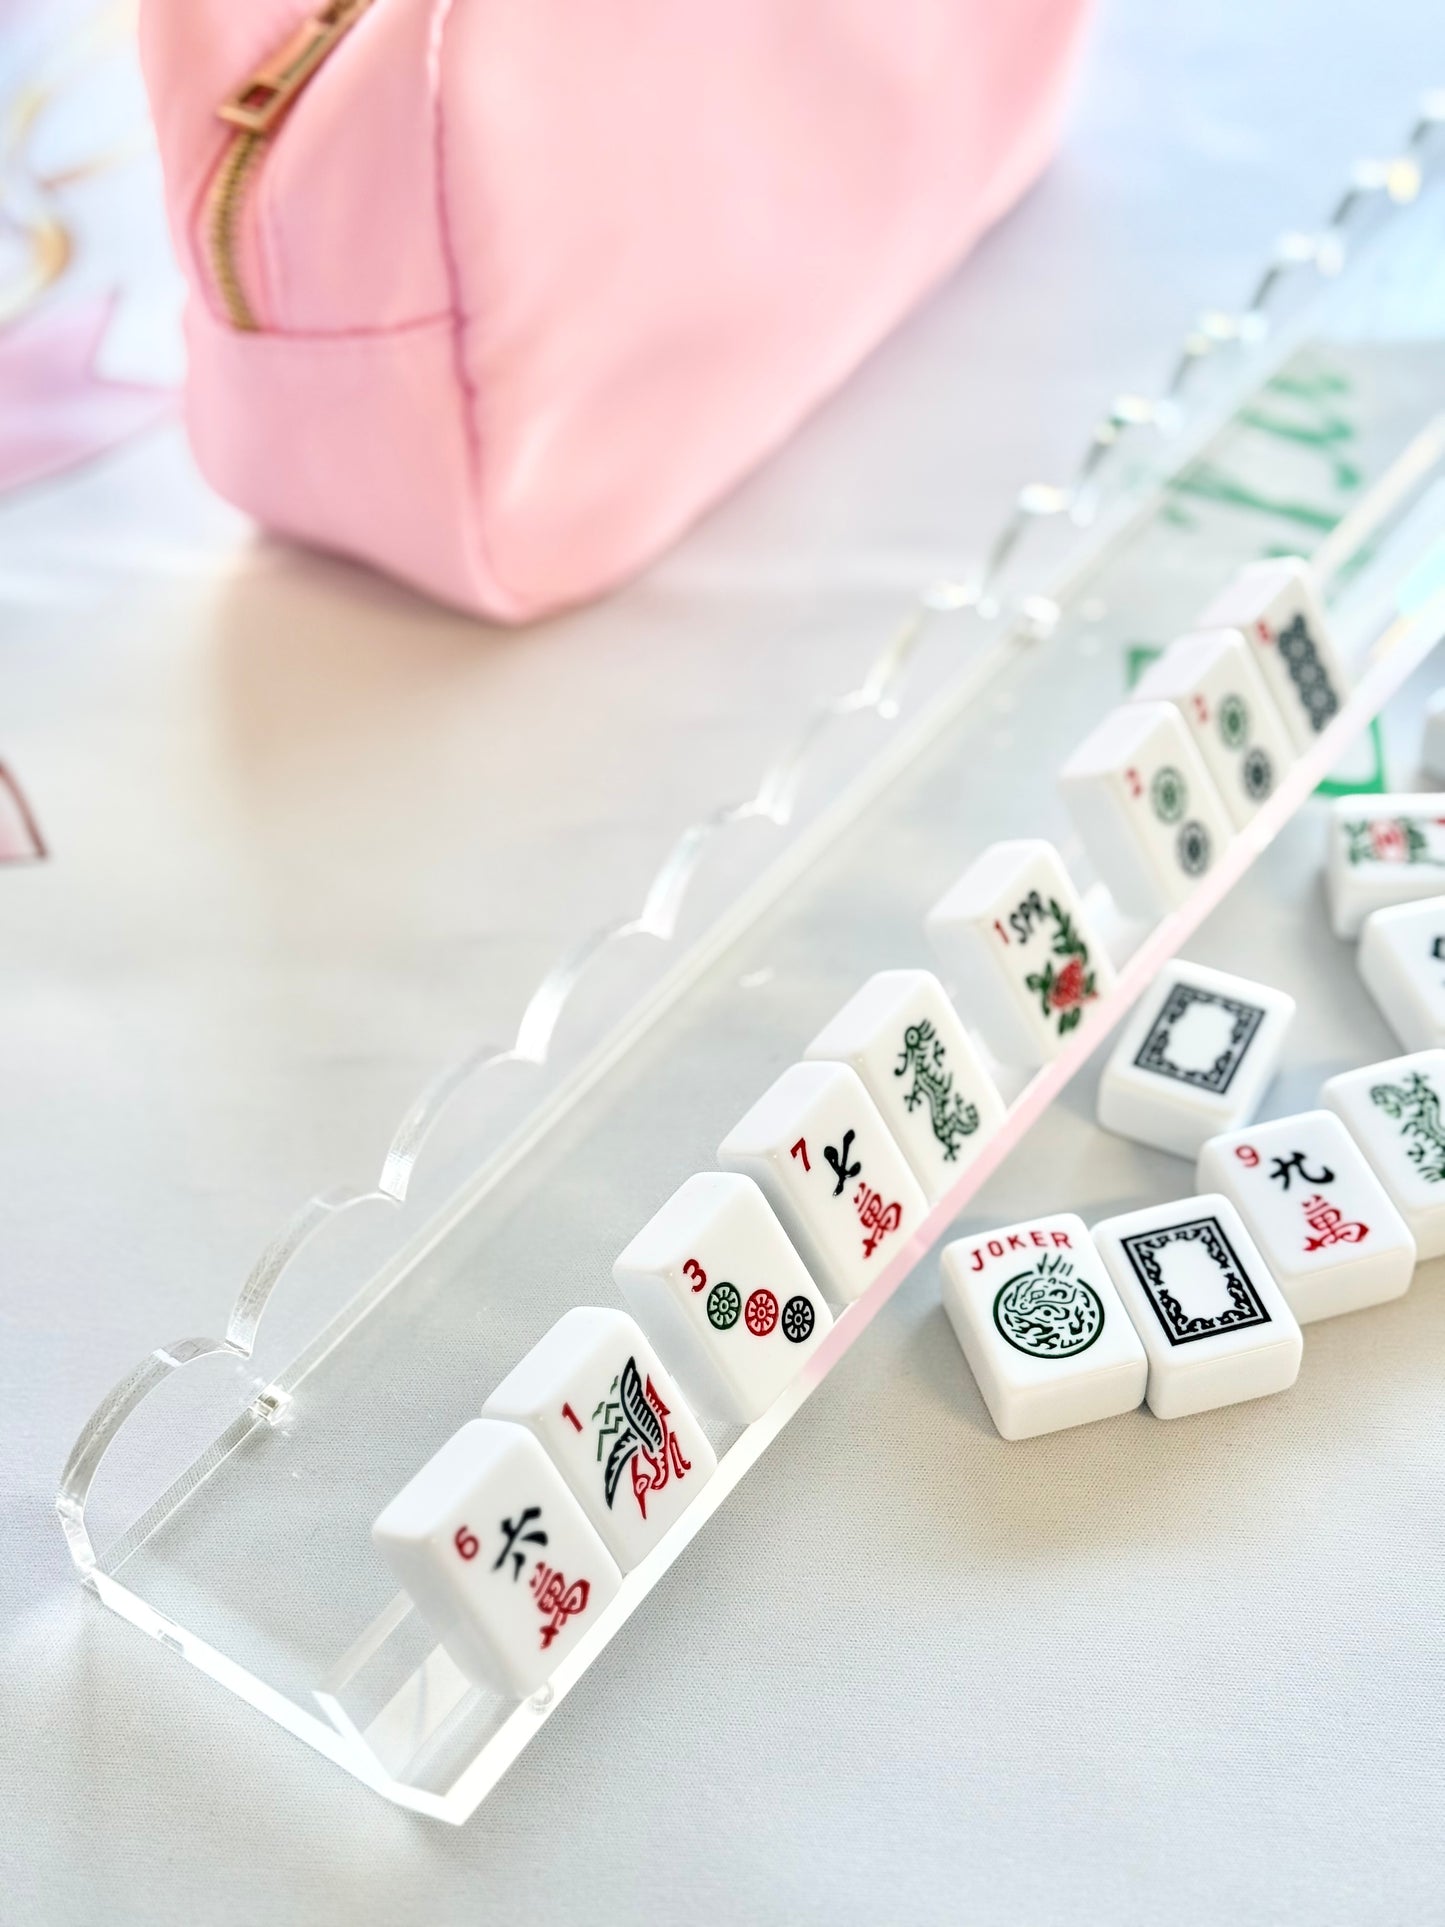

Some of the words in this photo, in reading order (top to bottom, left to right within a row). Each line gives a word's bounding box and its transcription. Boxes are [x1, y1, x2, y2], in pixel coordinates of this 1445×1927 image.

[994, 919, 1010, 945] 1
[791, 1138, 811, 1172] 7
[1235, 1145, 1260, 1168] 9
[971, 1231, 1073, 1272] JOKER
[683, 1258, 707, 1293] 3
[561, 1402, 583, 1433] 1
[454, 1525, 479, 1561] 6
